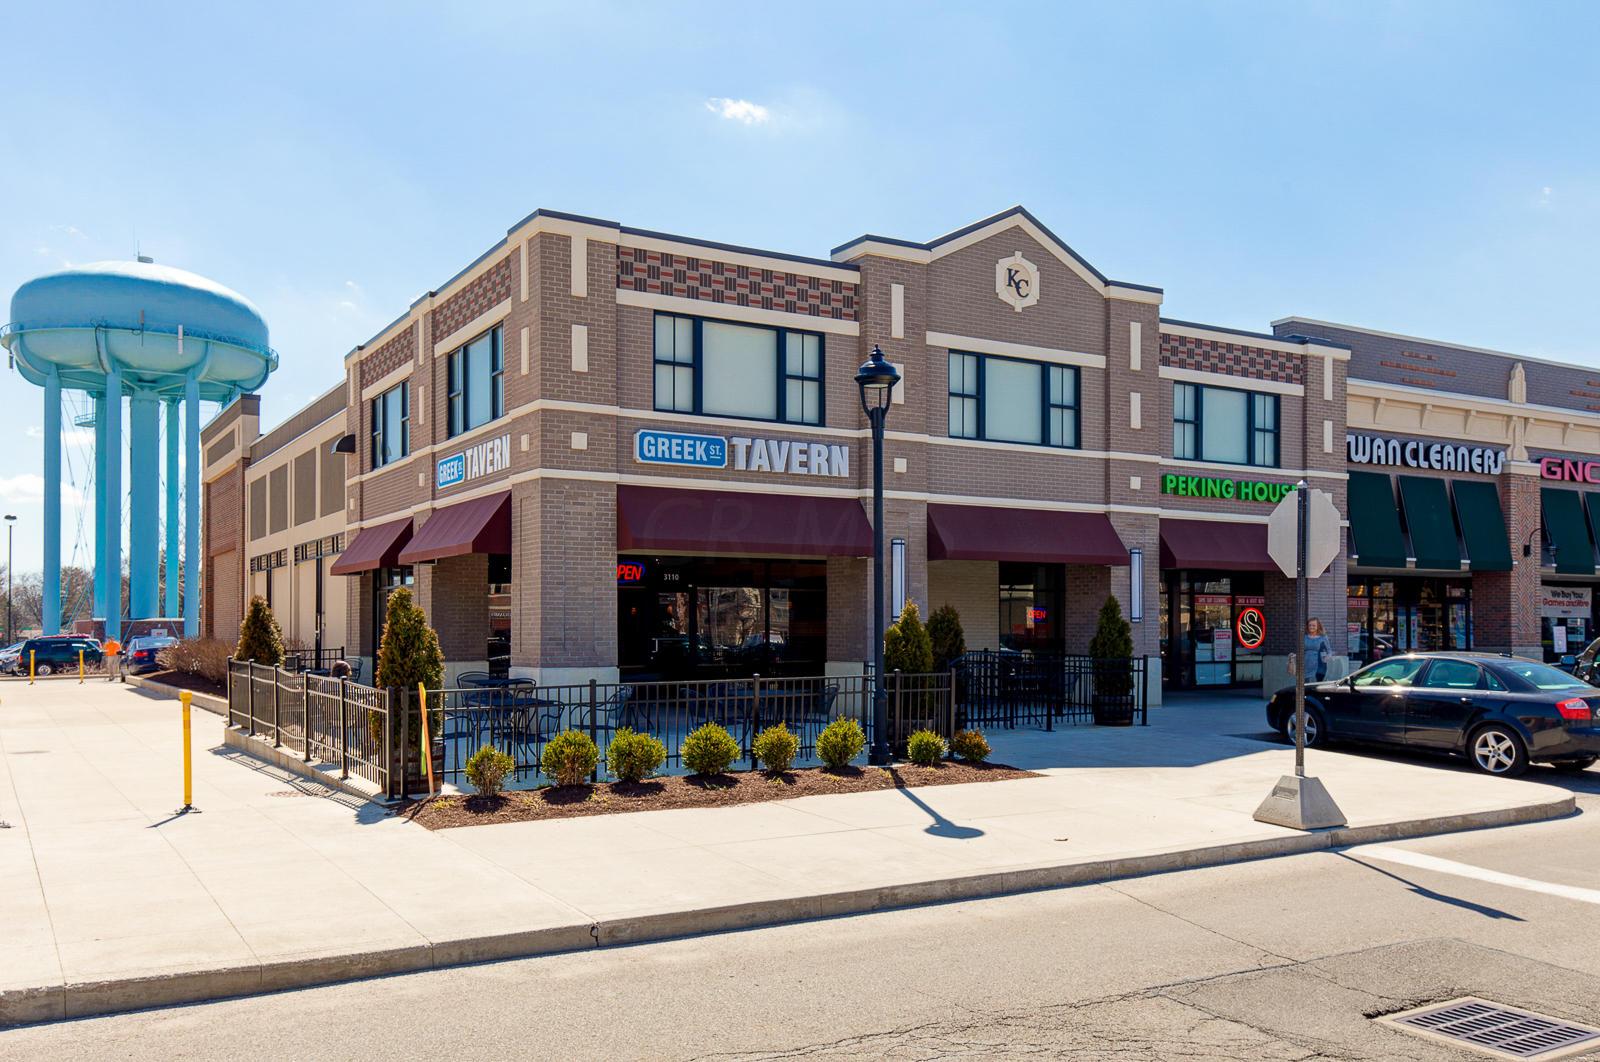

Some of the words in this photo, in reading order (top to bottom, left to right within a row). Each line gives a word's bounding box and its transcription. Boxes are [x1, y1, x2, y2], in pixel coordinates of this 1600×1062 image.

[465, 434, 511, 480] TAVERN
[643, 436, 708, 462] GREEK
[709, 445, 722, 459] ST.
[730, 436, 850, 478] TAVERN
[1346, 434, 1400, 465] WAN
[1405, 441, 1506, 475] CLEANERS
[1540, 457, 1600, 484] GNC
[1164, 473, 1235, 499] PEKING
[1240, 480, 1297, 503] HOUS
[616, 564, 643, 581] PEN
[663, 573, 680, 581] 3110
